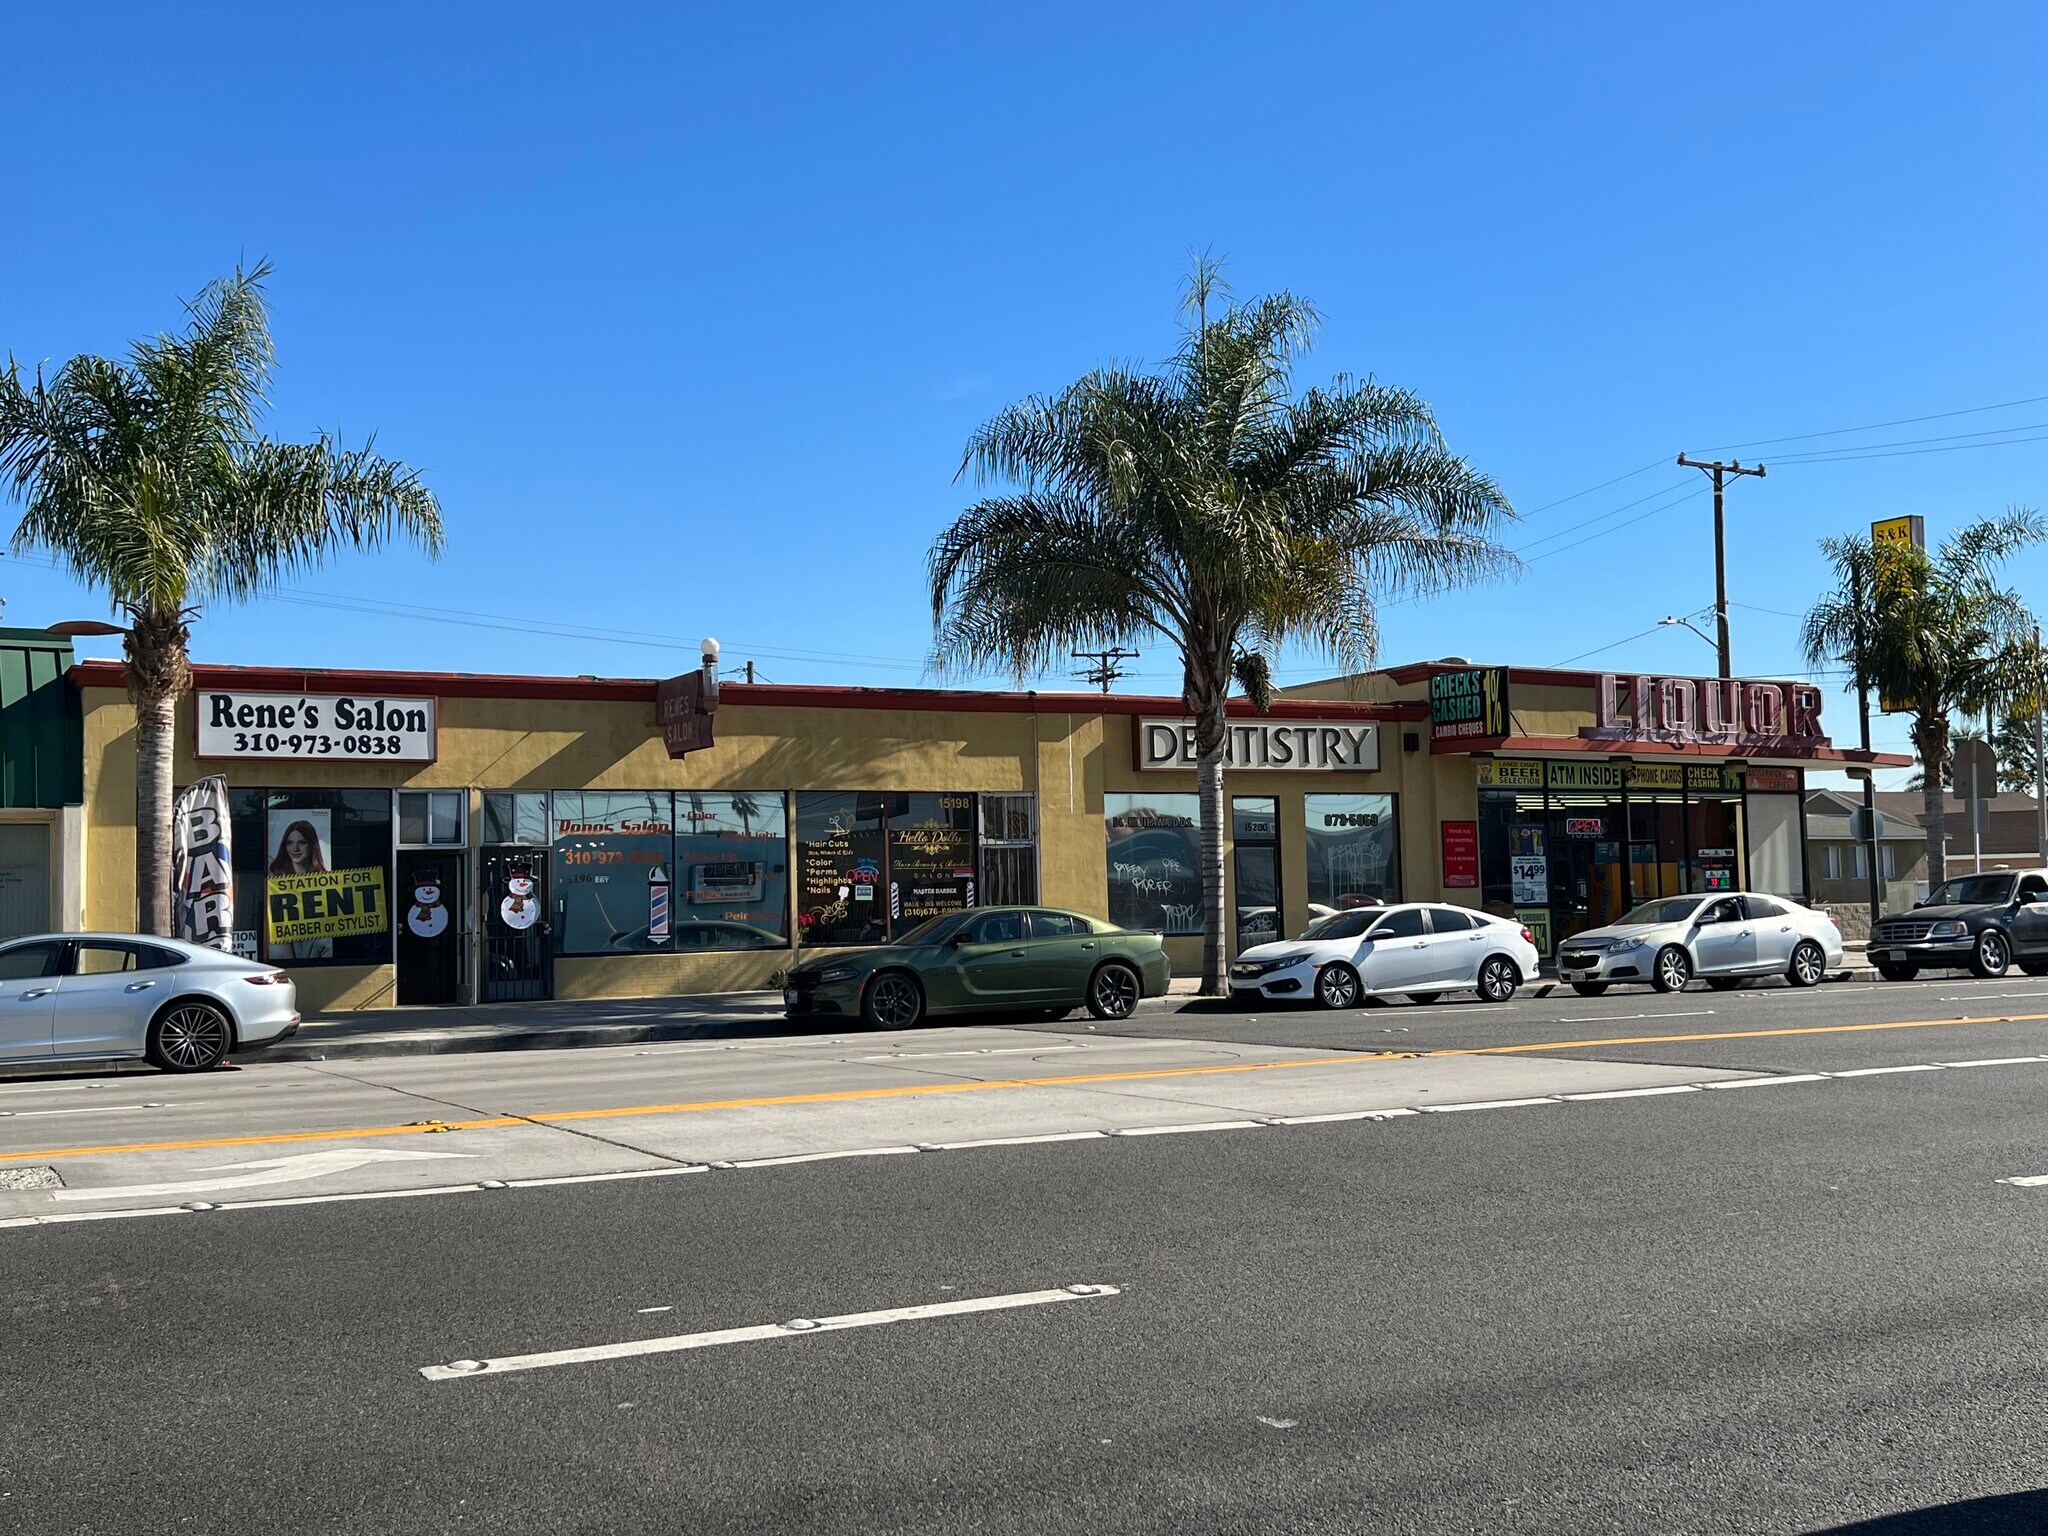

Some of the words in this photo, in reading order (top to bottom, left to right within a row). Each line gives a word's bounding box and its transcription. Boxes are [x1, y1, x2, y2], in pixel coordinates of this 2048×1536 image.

[1432, 671, 1480, 698] CHECKS
[1433, 695, 1481, 722] CASHED
[1483, 670, 1502, 735] 1%
[1602, 674, 1825, 739] LIQUOR
[209, 694, 319, 729] Rene's
[335, 697, 427, 733] Salon
[1436, 724, 1457, 738] CAMBIO
[1458, 721, 1483, 736] CHEQUES
[233, 733, 401, 755] 310-973-0838
[1148, 725, 1372, 765] DETISTRY
[1499, 768, 1540, 777] BEER
[1550, 766, 1575, 784] ATM
[1579, 766, 1619, 785] INSIDE
[1637, 768, 1658, 783] PHONE
[1660, 768, 1682, 784] CARDS
[1687, 767, 1719, 779] CHECK
[1687, 779, 1719, 788] CASHING
[938, 798, 969, 808] 15198
[1244, 823, 1268, 832] 15200
[1568, 820, 1600, 833] OPEN
[899, 830, 929, 843] Hello
[931, 830, 961, 846] Dolly
[278, 875, 339, 891] STATION
[344, 872, 371, 885] FOR
[810, 877, 852, 886] Highlights
[846, 869, 878, 883] OPEN
[810, 886, 831, 894] Nails
[270, 884, 381, 923] RENT
[276, 922, 321, 938] BARBER
[325, 922, 335, 933] or
[338, 915, 381, 932] STYLIST
